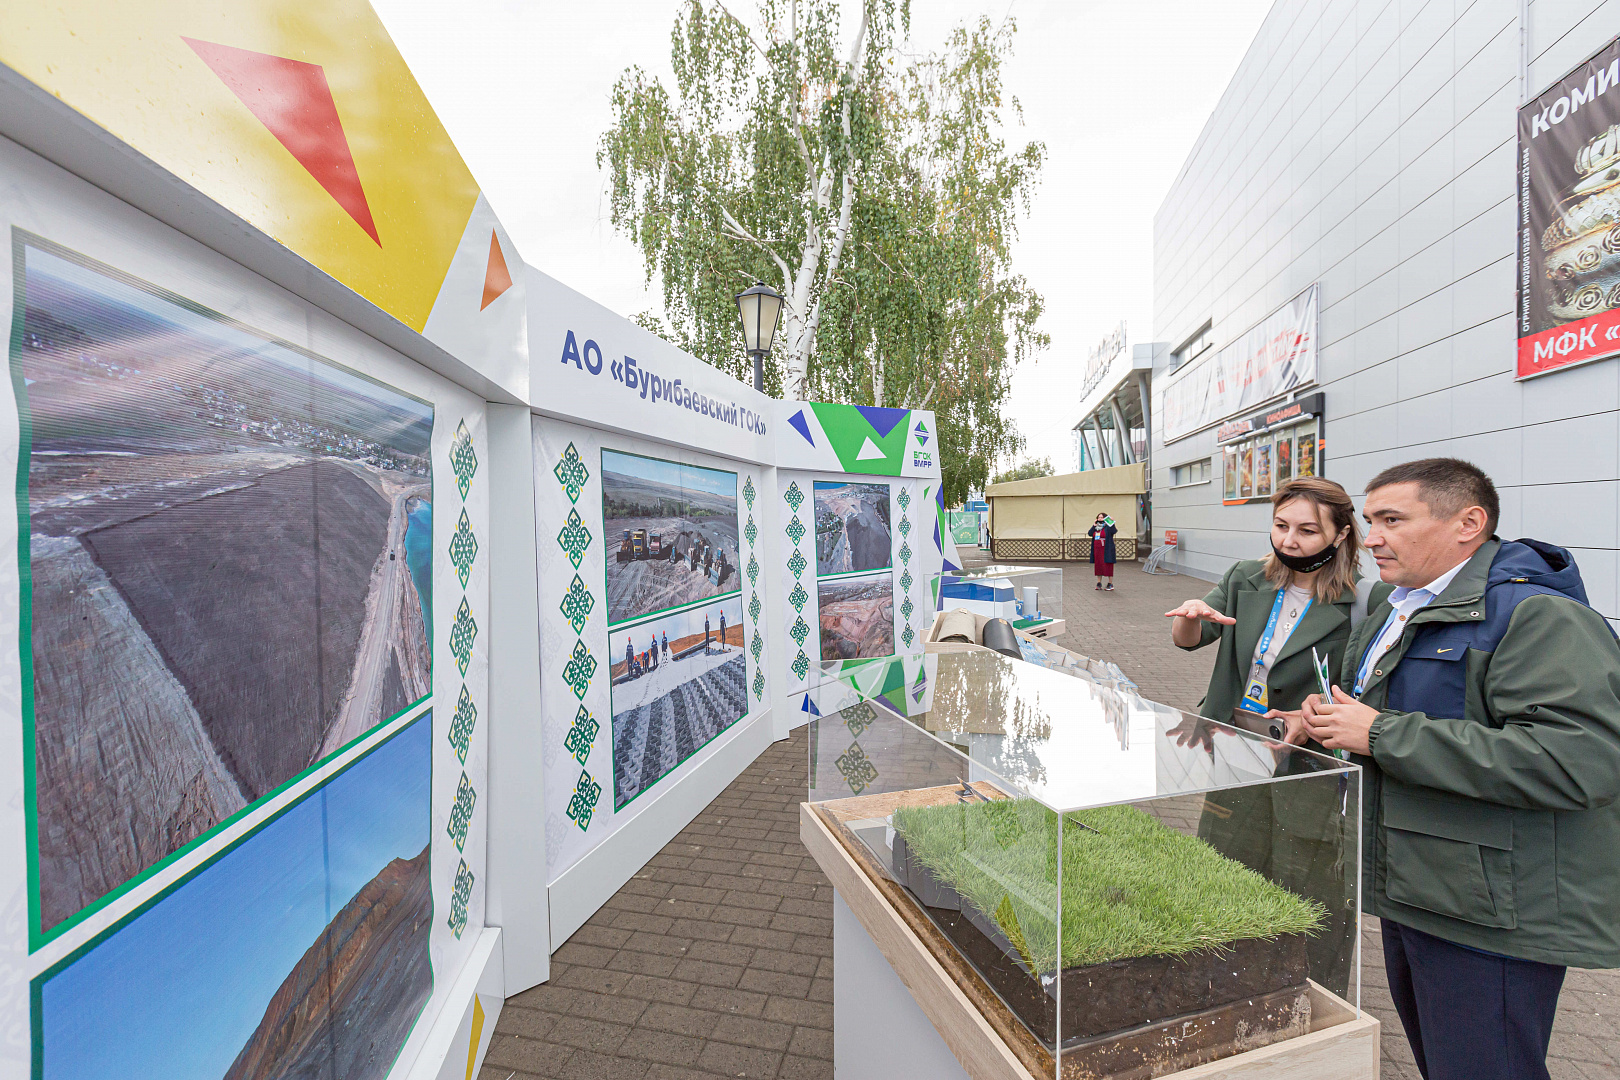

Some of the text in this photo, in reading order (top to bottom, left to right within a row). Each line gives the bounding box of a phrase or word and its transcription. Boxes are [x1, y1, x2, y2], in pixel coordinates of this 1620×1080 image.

[1522, 296, 1530, 332] ОГРНИП
[1533, 323, 1599, 363] МФК
[561, 329, 767, 436] АО «Бурибаевский ГОК»
[913, 450, 931, 460] БГОК
